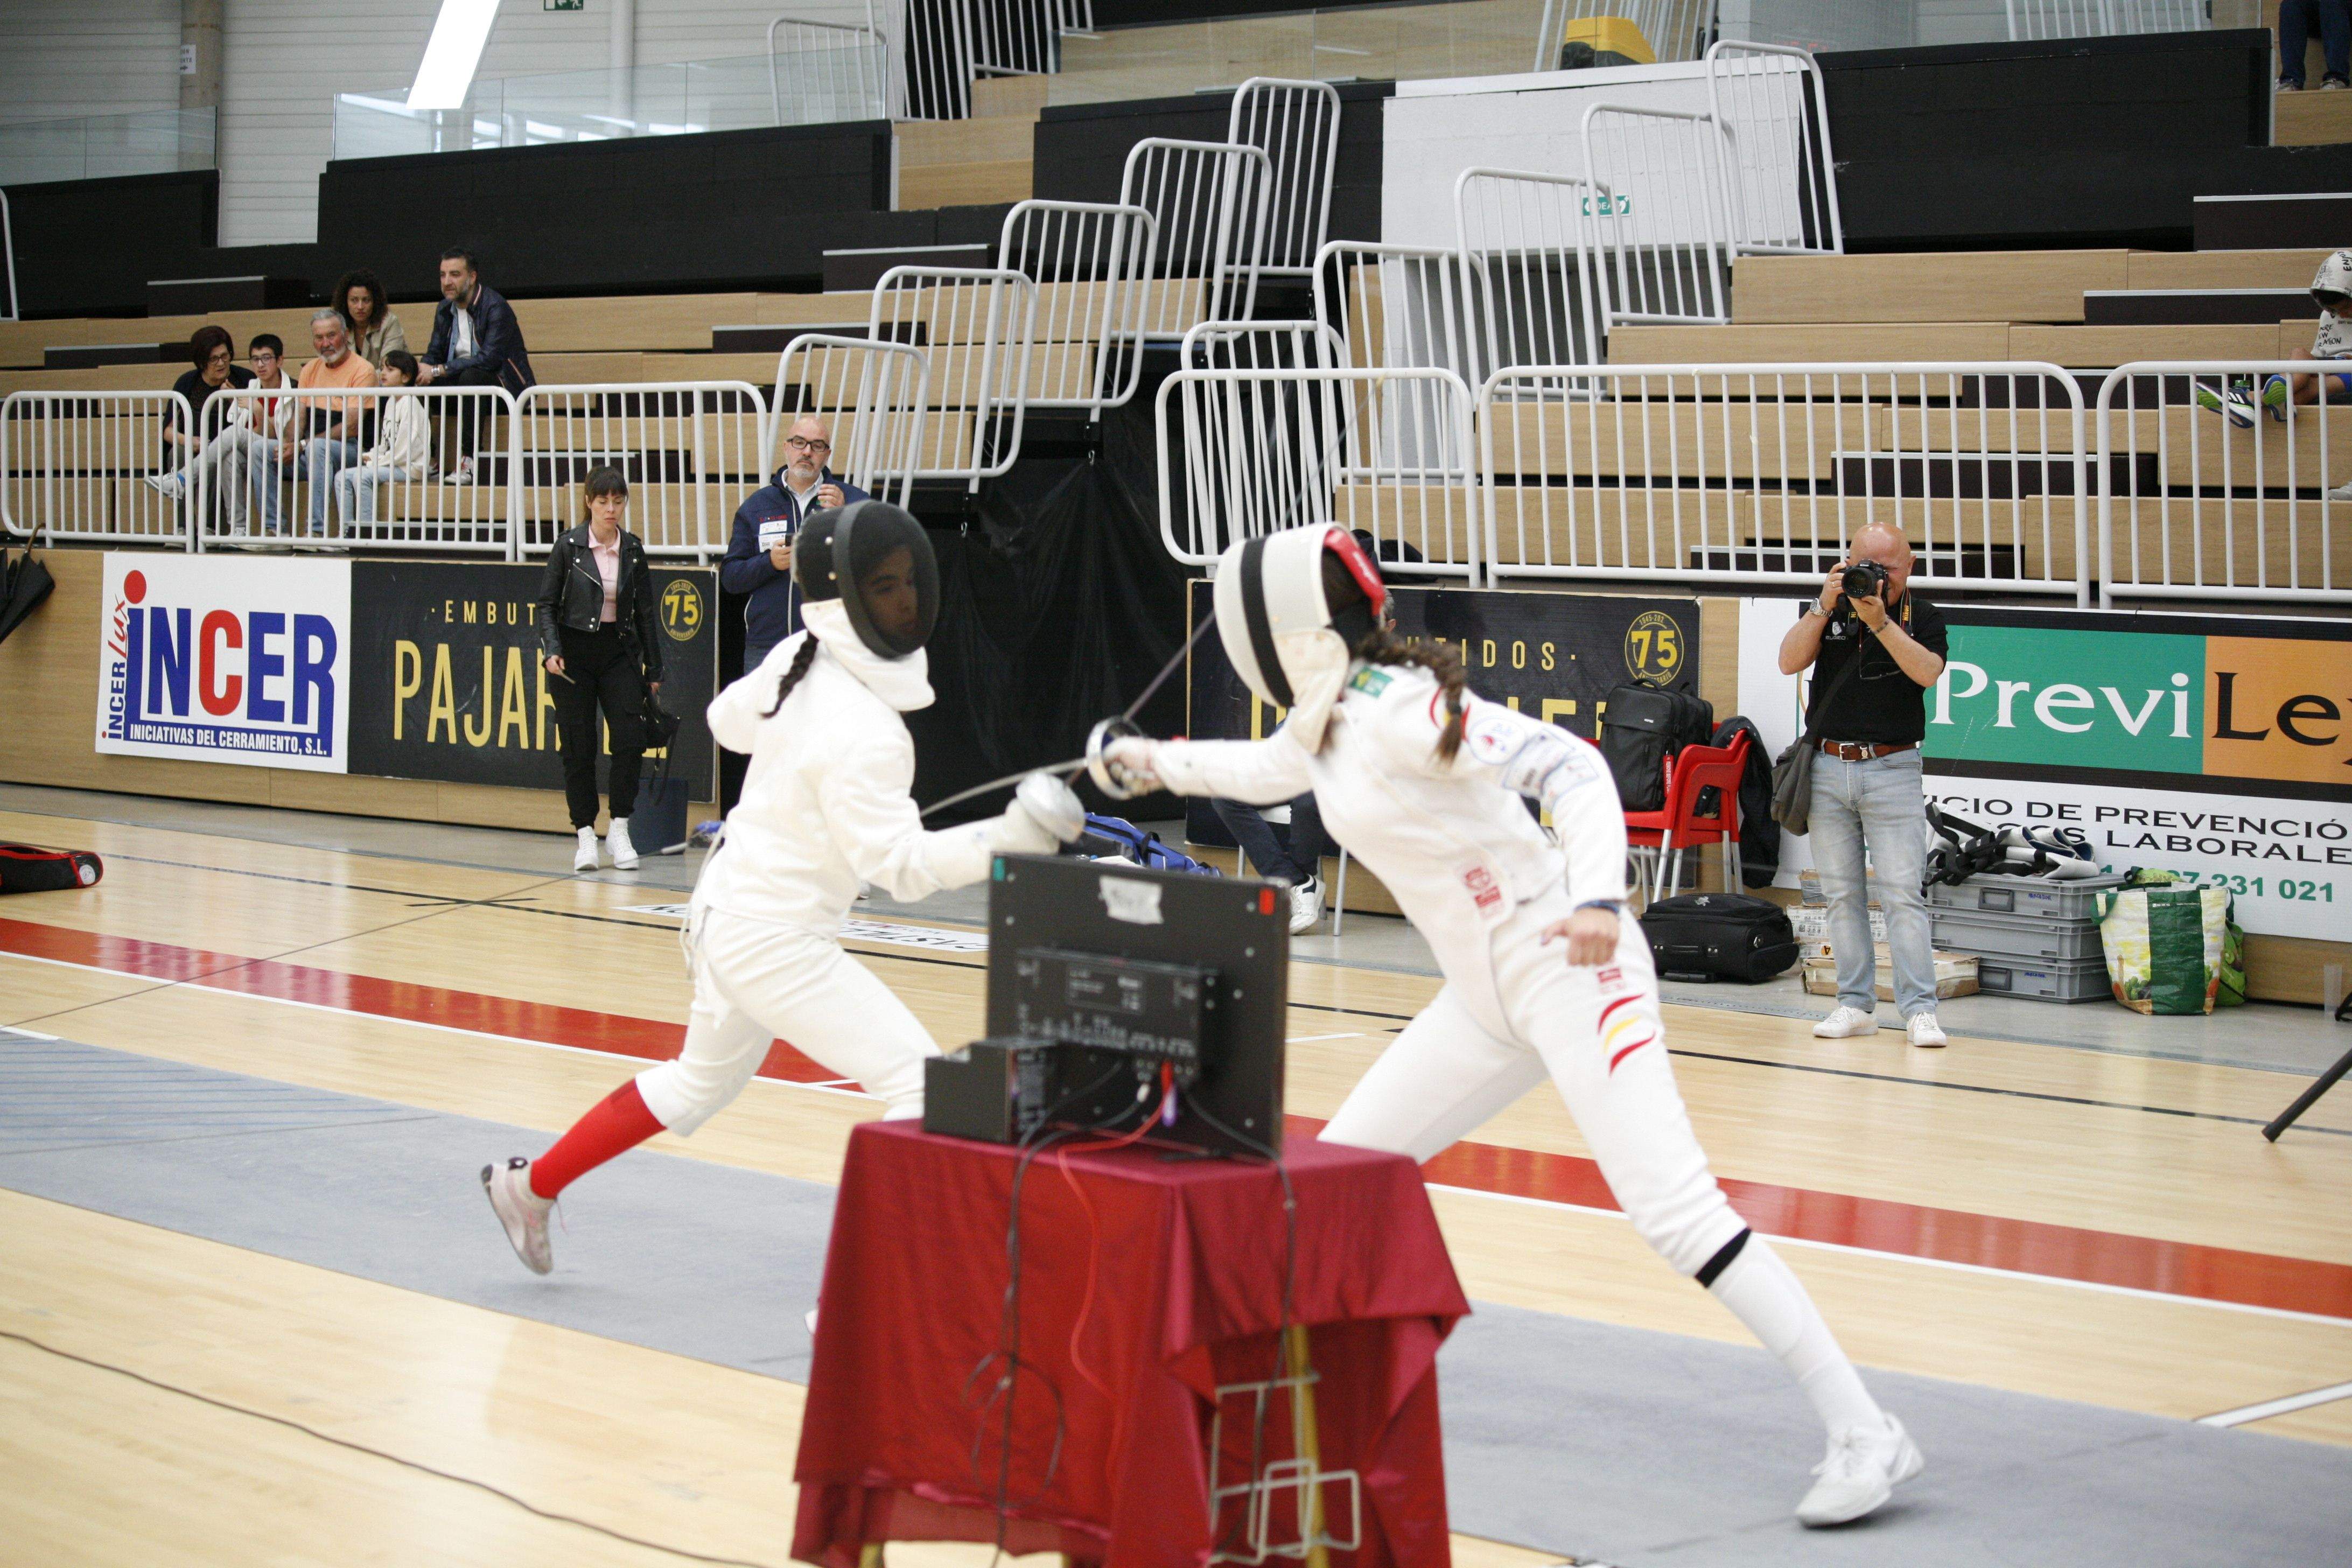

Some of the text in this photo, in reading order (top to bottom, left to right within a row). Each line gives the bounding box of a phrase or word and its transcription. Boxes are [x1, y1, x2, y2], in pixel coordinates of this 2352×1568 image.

[665, 594, 698, 626] 75
[1631, 630, 1677, 668] 75
[1930, 661, 2352, 765] PreviLe
[130, 724, 327, 755] INICIATIVAS DEL CERRAMIENTO, S.L.
[2026, 801, 2082, 821] DE
[2211, 873, 2264, 897] 231
[2278, 879, 2333, 903] 021
